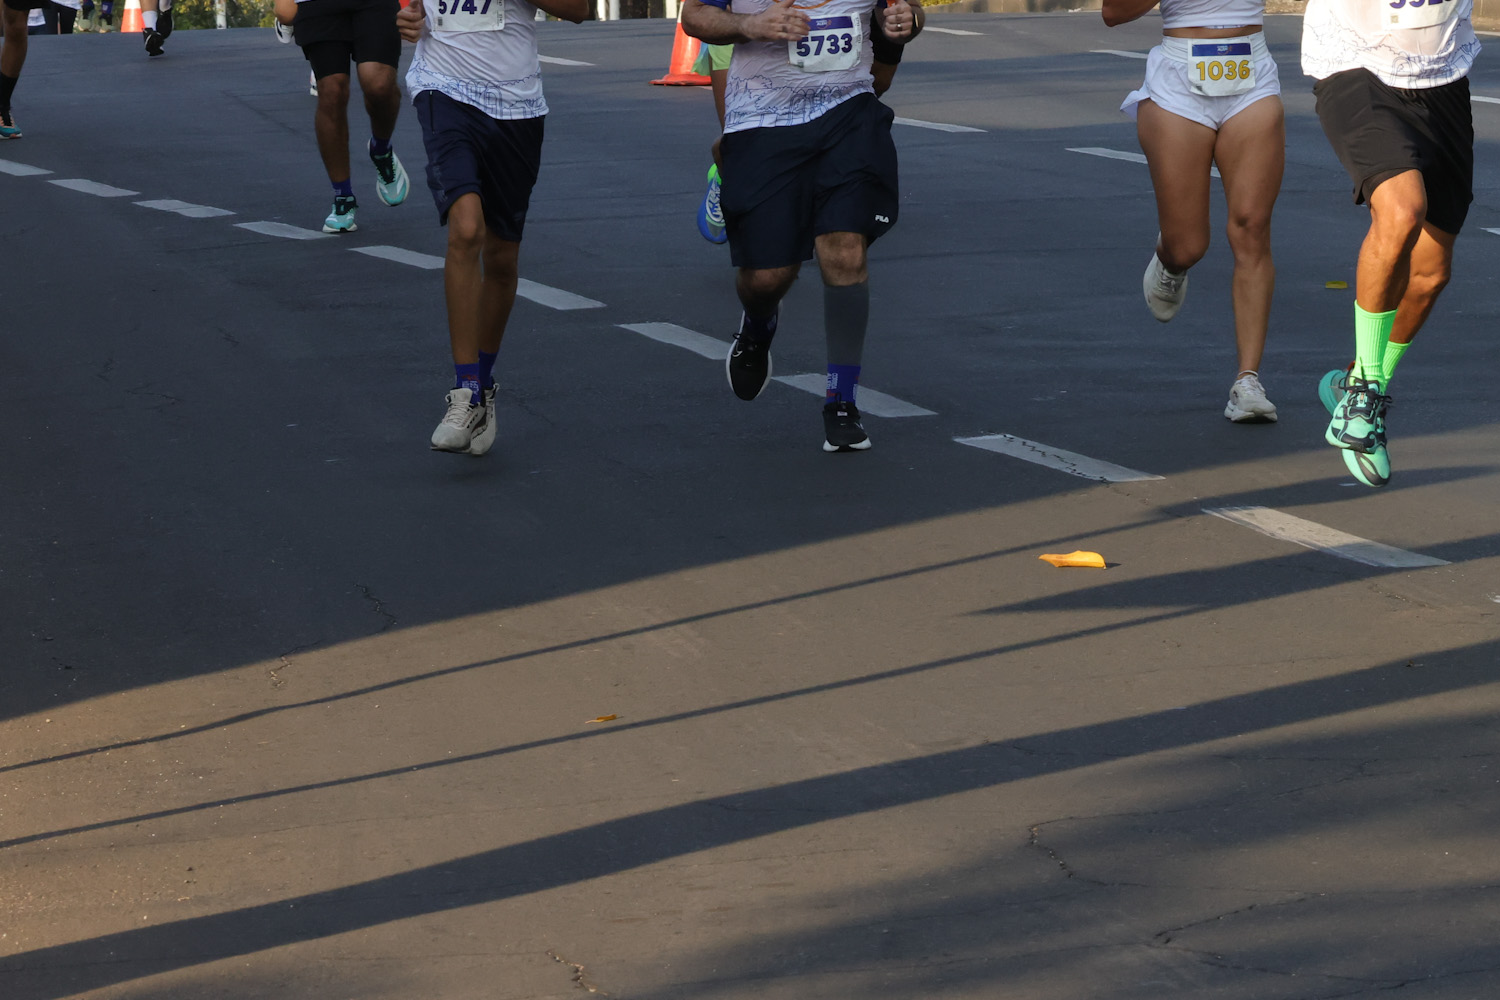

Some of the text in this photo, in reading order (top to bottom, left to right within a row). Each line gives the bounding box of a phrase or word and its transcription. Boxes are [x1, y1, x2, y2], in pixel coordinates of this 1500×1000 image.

[796, 33, 853, 57] 5733
[1196, 60, 1251, 81] 1036
[875, 215, 889, 223] FILA
